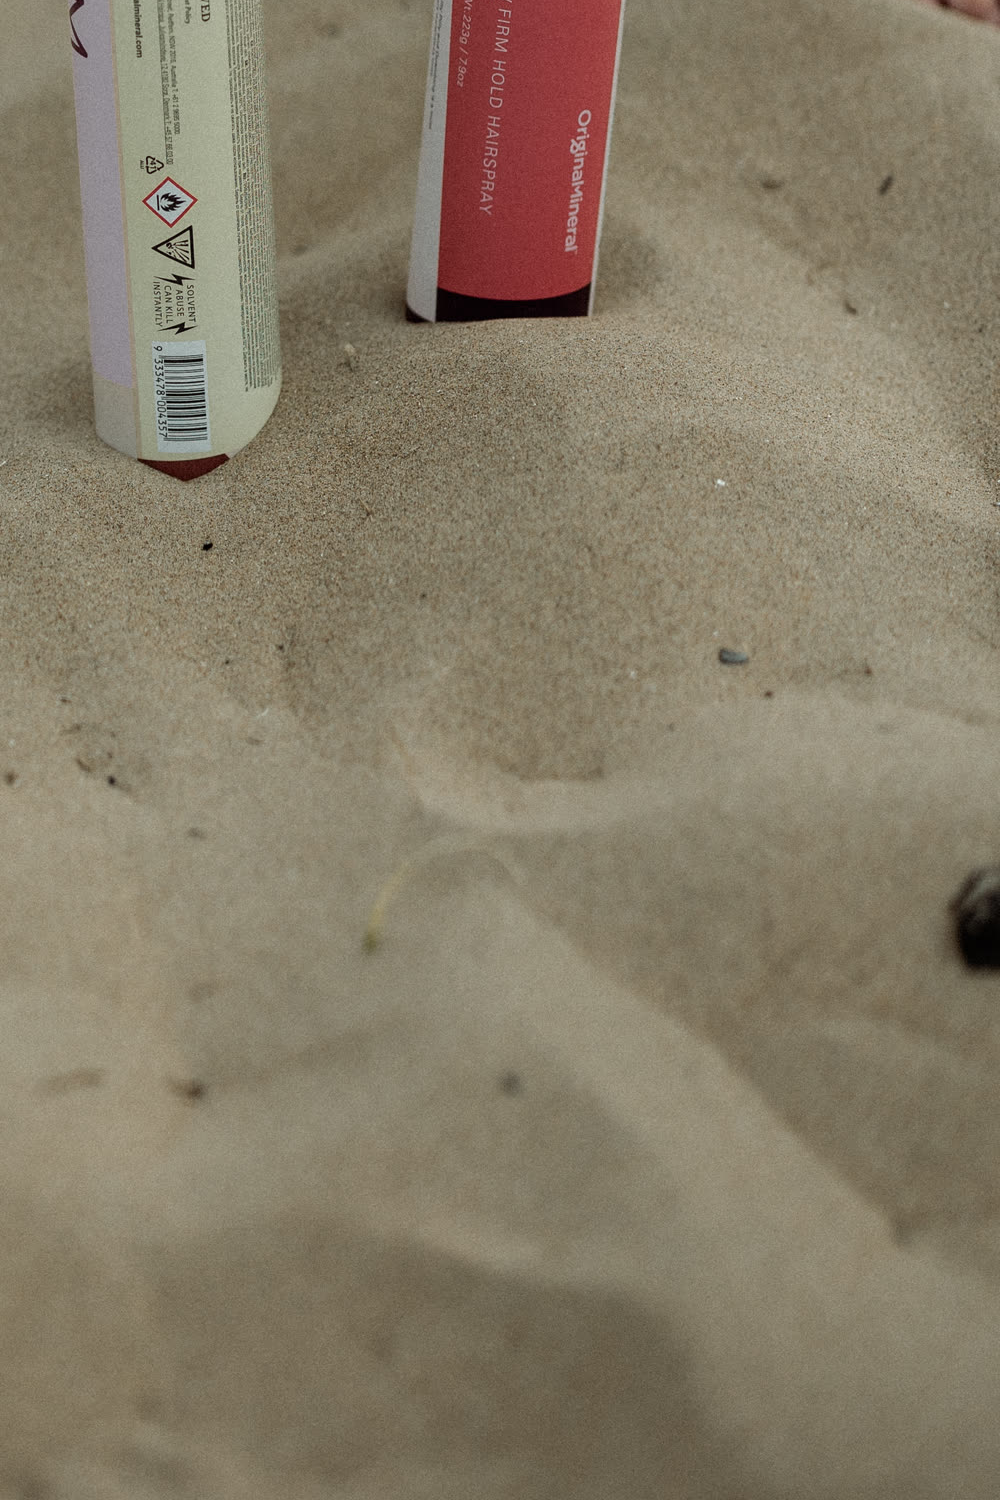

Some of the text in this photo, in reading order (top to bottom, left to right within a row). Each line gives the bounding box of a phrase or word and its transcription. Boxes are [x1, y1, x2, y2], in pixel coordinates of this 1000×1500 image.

[493, 7, 512, 52] FIRM
[488, 58, 506, 108] HOLD
[478, 114, 501, 215] HAIRSPRAY
[564, 108, 592, 252] OriginalMineral
[152, 281, 162, 326] INSTANTLY
[163, 285, 172, 323] CAN KILL
[175, 289, 184, 316] ABUSE
[186, 284, 195, 322] SOLVENT
